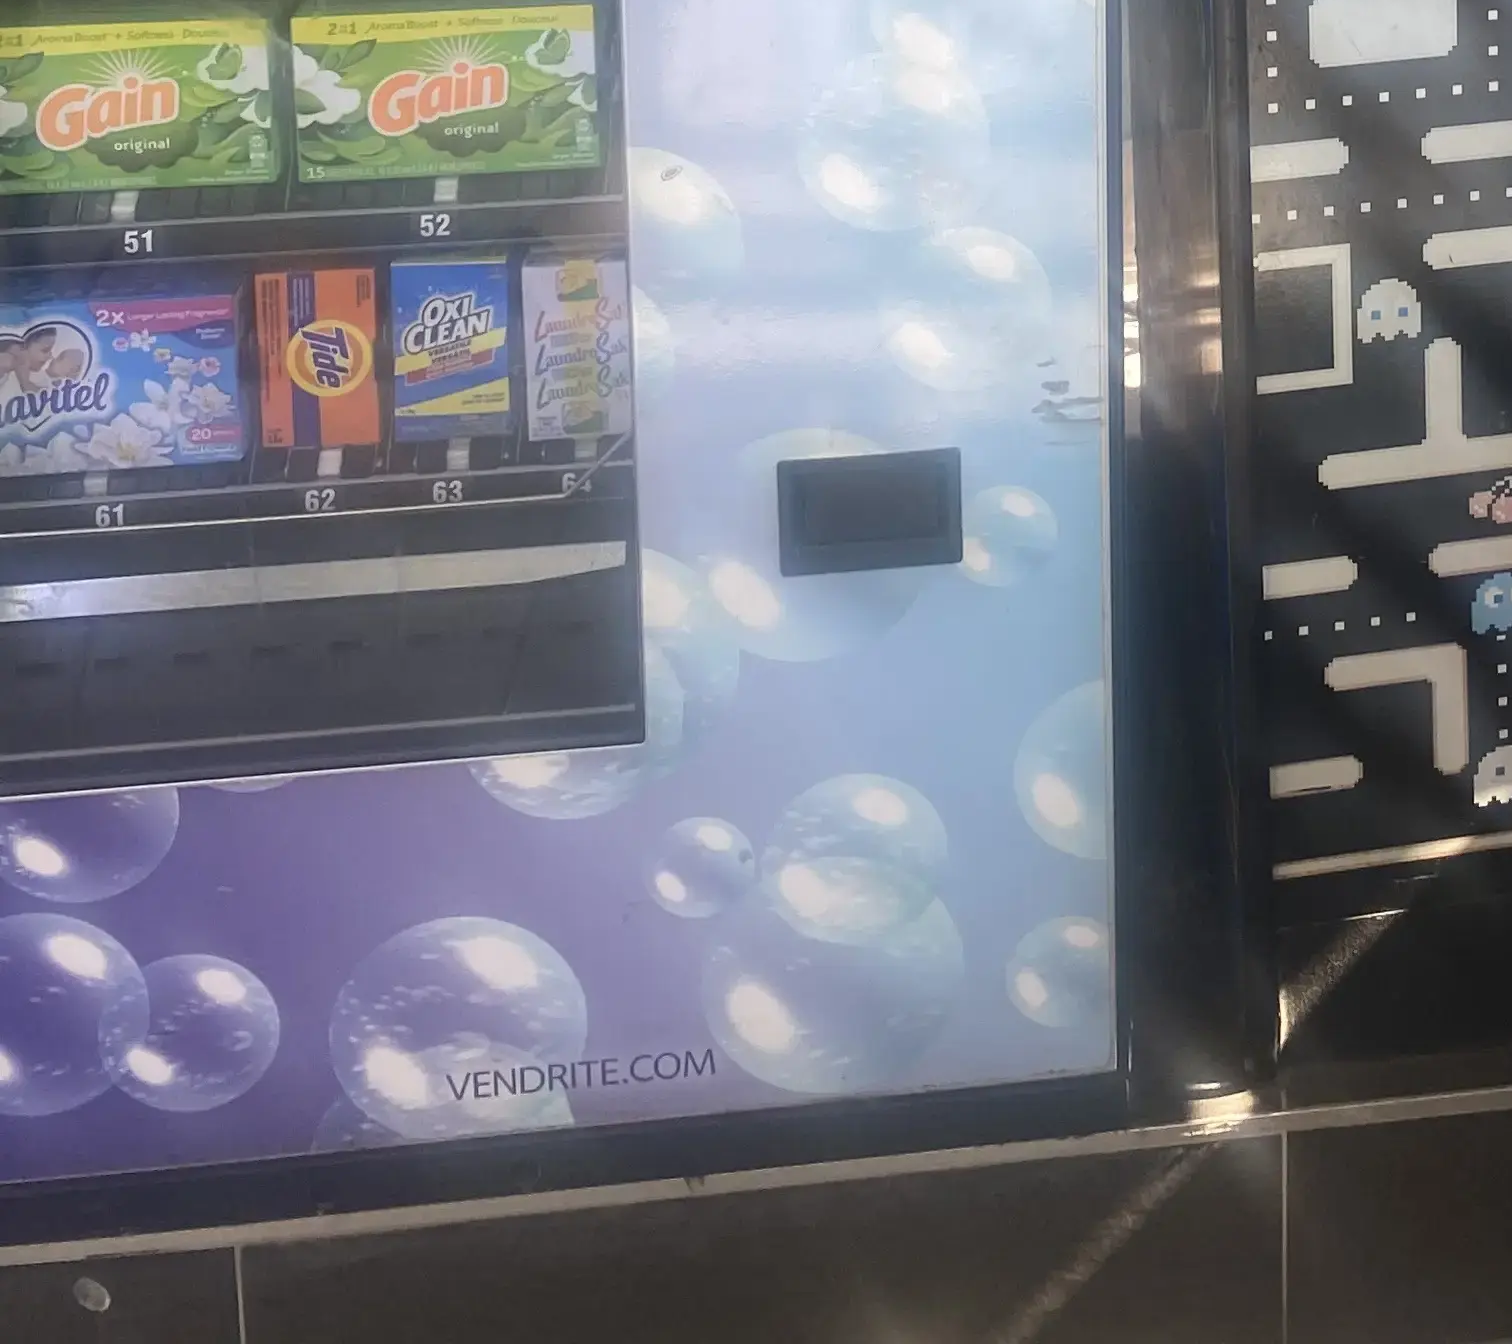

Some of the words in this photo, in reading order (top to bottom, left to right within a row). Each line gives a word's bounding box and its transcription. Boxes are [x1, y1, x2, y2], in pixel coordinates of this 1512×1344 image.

[36, 72, 180, 151] Gain
[368, 62, 508, 137] Gain
[444, 121, 500, 139] original
[114, 137, 171, 154] original
[306, 166, 326, 180] 15
[420, 213, 451, 238] 52
[124, 229, 154, 254] 51
[421, 292, 474, 328] OXI
[402, 307, 491, 355] CLEAN
[300, 326, 350, 389] Tide
[0, 371, 110, 427] avitel
[191, 428, 212, 442] 20
[305, 488, 336, 512] 62
[432, 480, 463, 504] 63
[95, 504, 125, 528] 61
[446, 1047, 717, 1102] VENDRITE.COM
